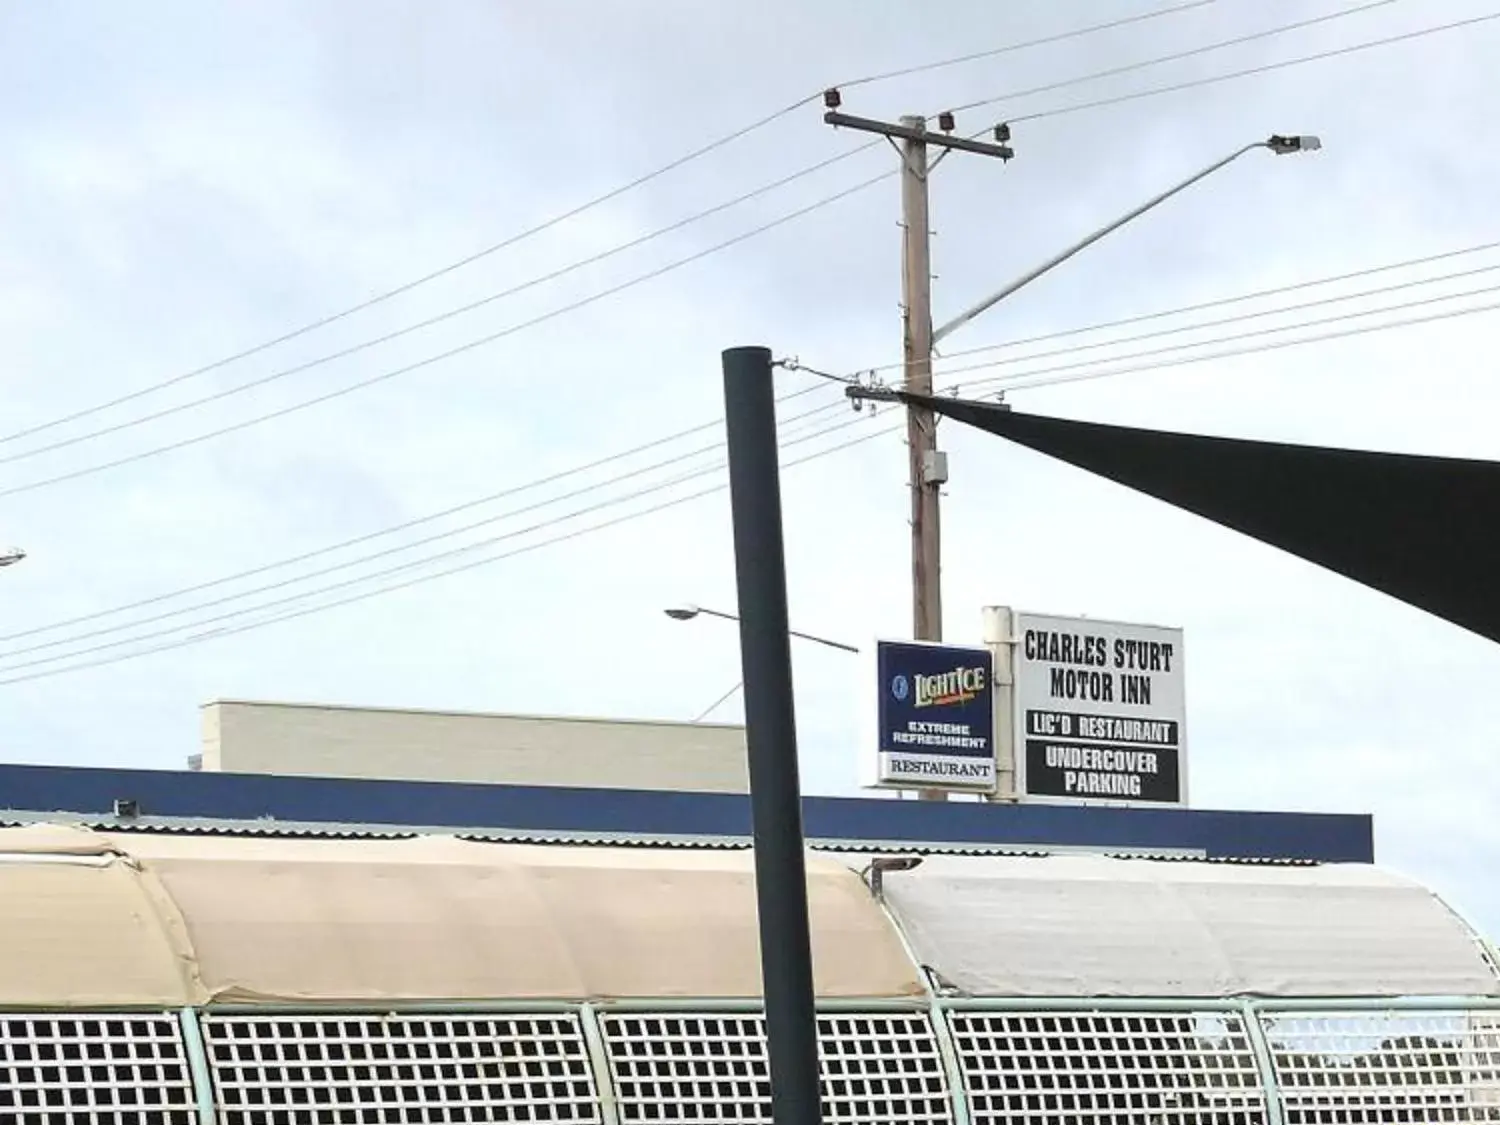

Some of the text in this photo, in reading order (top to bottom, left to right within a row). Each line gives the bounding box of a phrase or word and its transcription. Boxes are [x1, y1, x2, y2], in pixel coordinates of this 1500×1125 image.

[1025, 630, 1173, 672] CHARLES STURT
[1050, 668, 1151, 705] MOTOR INN
[893, 732, 987, 748] REFRESHMENT
[908, 721, 970, 736] EXTREME
[1033, 712, 1171, 743] LIC'D RESTAURANT
[891, 760, 990, 777] RESTAURANT
[1045, 746, 1158, 773] UNDERCOVER
[1065, 771, 1141, 796] PARKING
